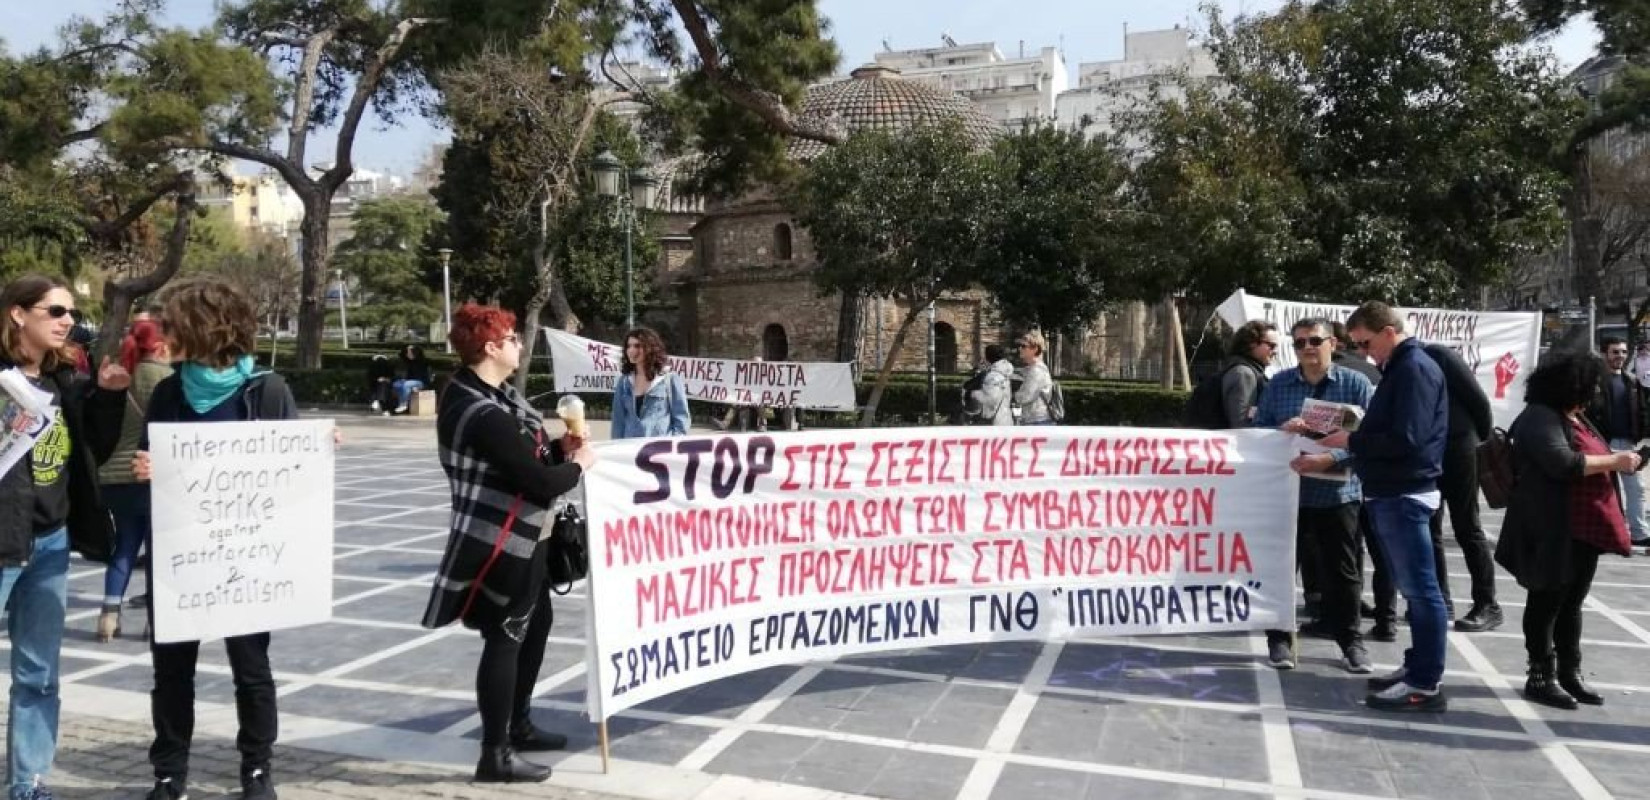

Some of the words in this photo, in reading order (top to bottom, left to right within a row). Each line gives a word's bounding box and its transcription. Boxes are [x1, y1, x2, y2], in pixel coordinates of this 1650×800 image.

[735, 362, 806, 387] ΜΠΡΟΣΤΑ
[171, 427, 319, 461] international
[780, 442, 855, 491] ΣΤΙΣ
[865, 437, 1047, 488] ΣΕΞΙΣΤΙΚΕΣ
[1060, 437, 1236, 477] ΔΙΑΚΡΙΣΕΙΣ
[633, 436, 775, 504] STOP
[209, 523, 261, 542] against
[604, 501, 815, 568] ΜΟΝΙΜΟΠΟΙΗΣΗ
[826, 497, 903, 539] ΟΛΩΝ
[913, 494, 966, 534] ΤΩΝ
[983, 487, 1216, 533] ΣΥΜΒΑΣΙΟΥΧΩΝ
[171, 541, 286, 576] patriarchy
[636, 556, 764, 629] ΜΑΖΙΚΕΣ
[777, 541, 958, 598] ΠΡΟΣΛΗΨΕΙΣ
[972, 540, 1031, 584] ΣΤΑ
[1043, 532, 1253, 577] ΝΟΣΟΚΟΜΕΙΑ
[178, 579, 294, 611] capitalism
[611, 623, 735, 697] ΣΩΜΑΤΕΙΟ
[748, 597, 940, 655] ΕΡΓΑΖΟΜΕΝΩΝ
[969, 591, 1039, 633] ΓΝΘ
[1051, 580, 1262, 627] "ΙΠΠΟΚΡΑΤΕΙΟ"
